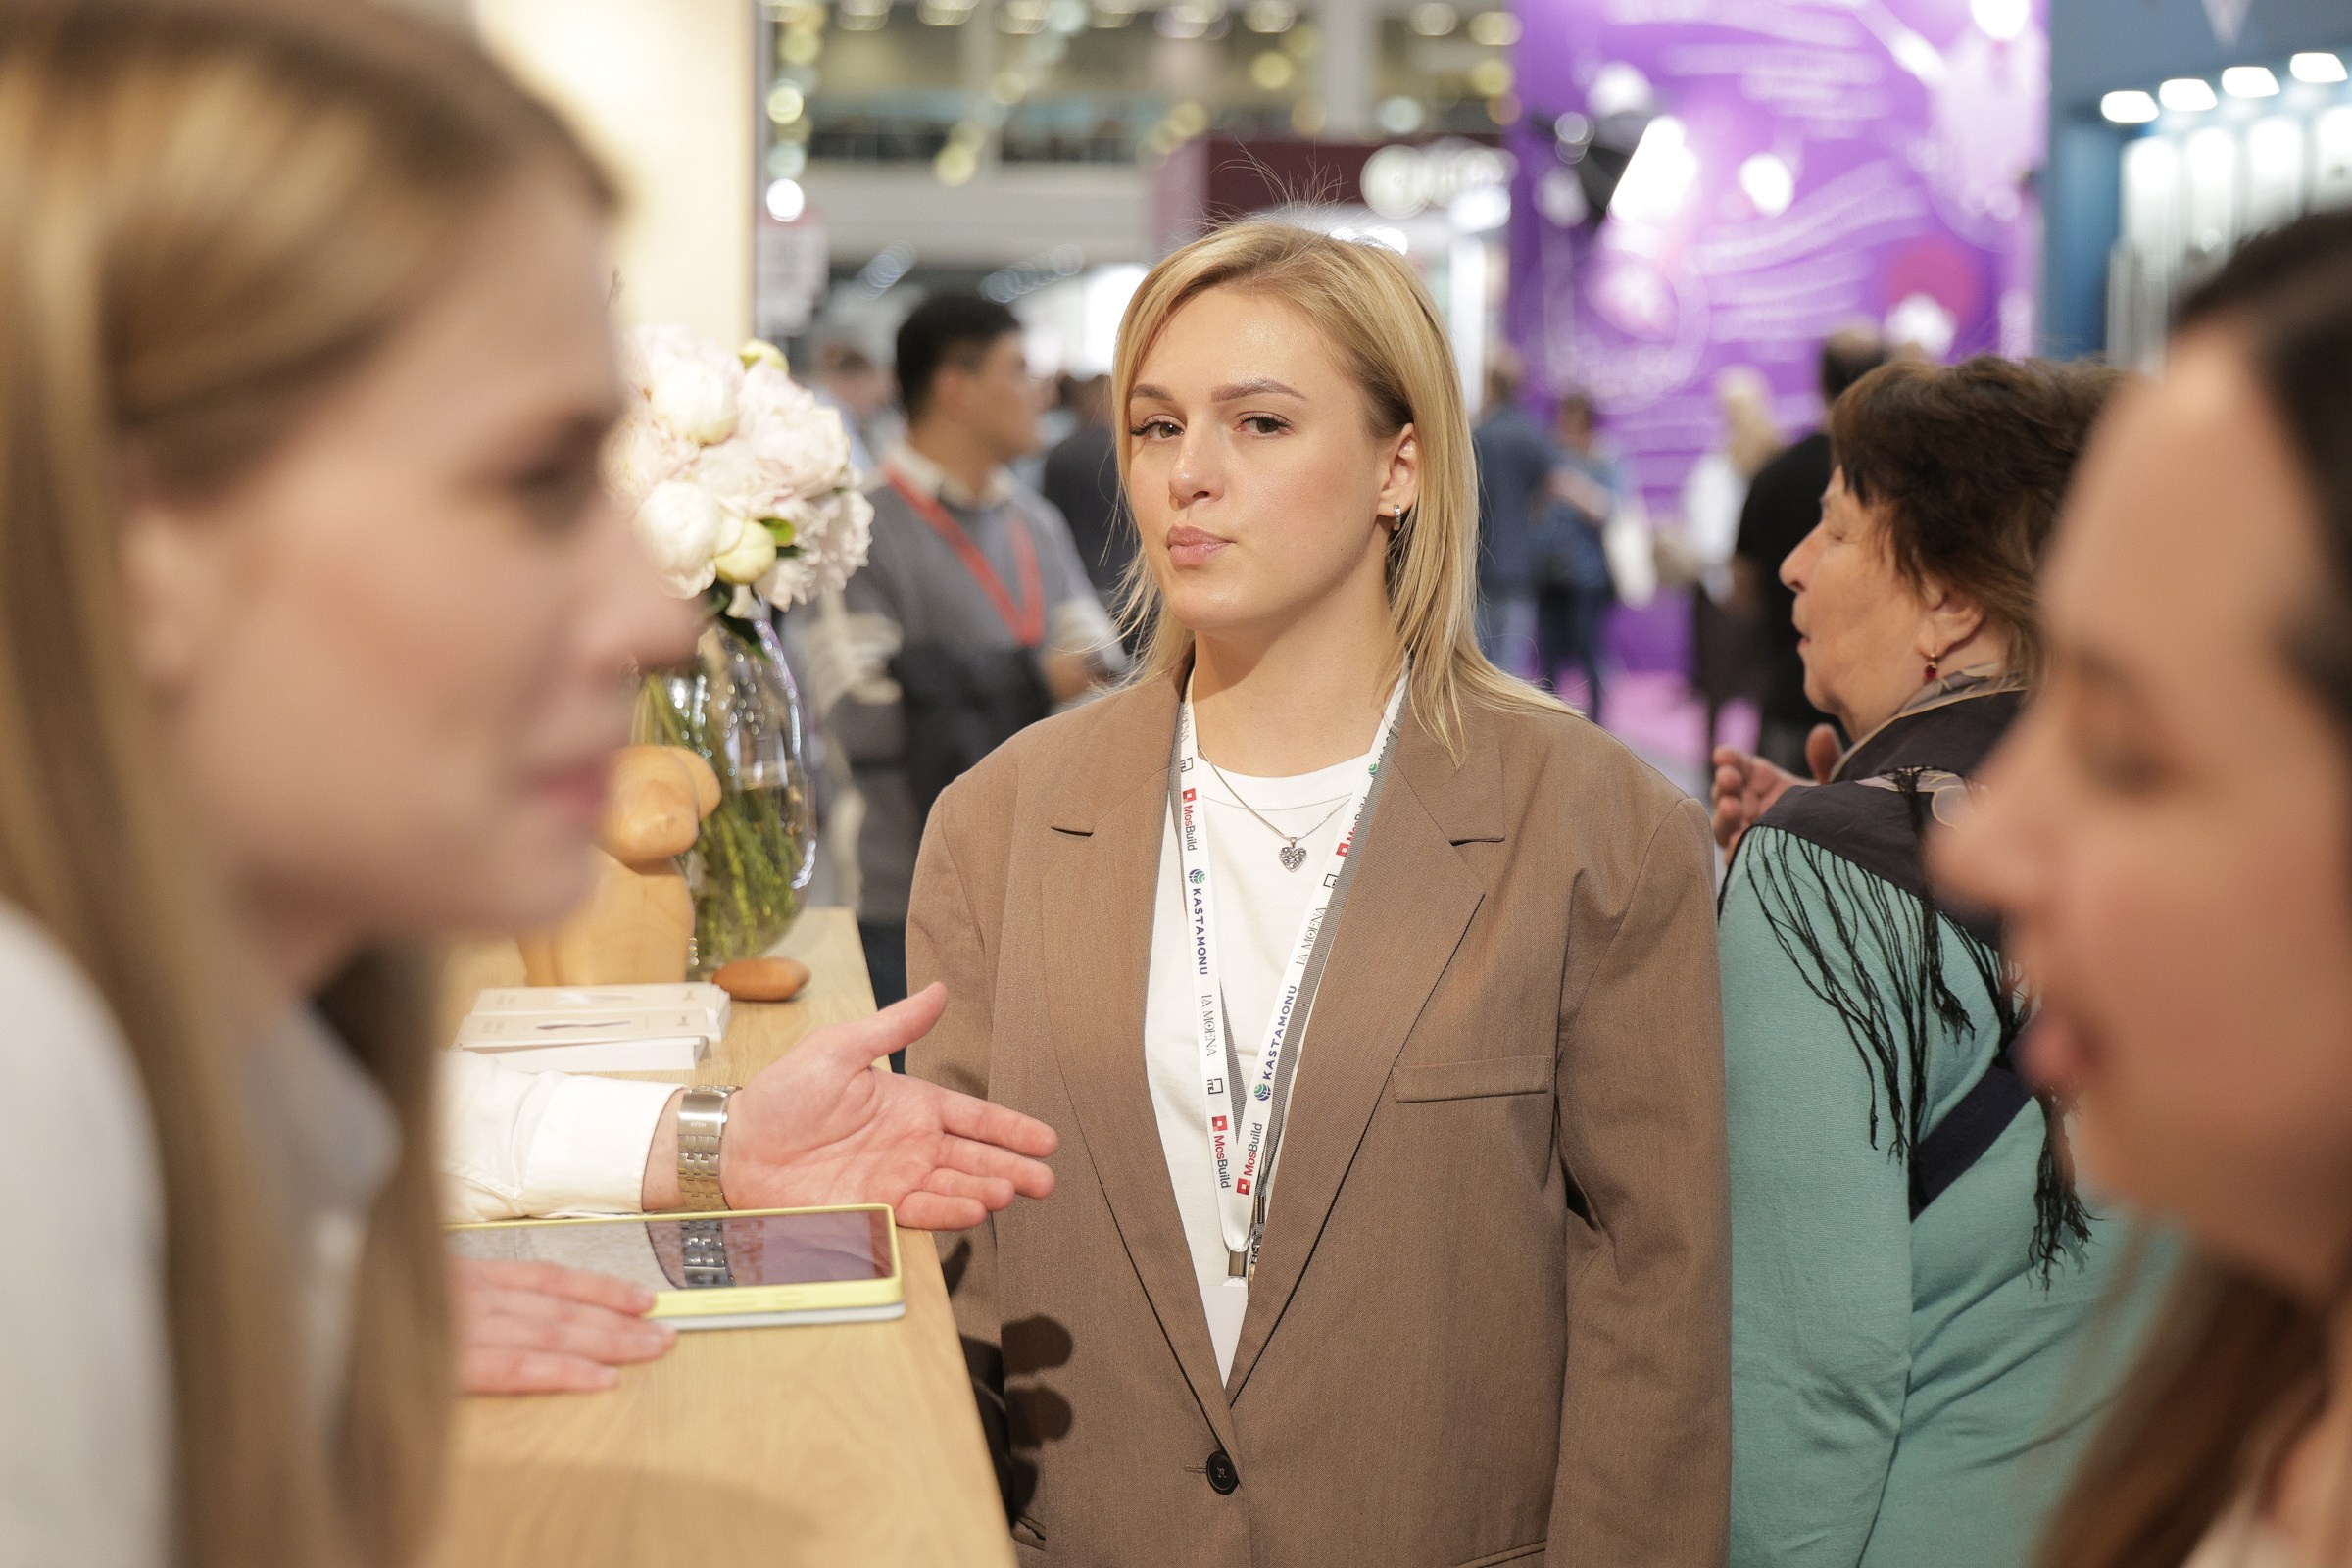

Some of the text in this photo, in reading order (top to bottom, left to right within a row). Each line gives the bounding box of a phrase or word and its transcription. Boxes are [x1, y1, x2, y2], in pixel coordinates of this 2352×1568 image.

[1184, 805, 1197, 851] MosBuild
[1193, 888, 1208, 975] KASTAMONU
[1301, 907, 1326, 950] MOENA
[1203, 1010, 1217, 1056] MOENA
[1262, 985, 1297, 1080] KASTAMONU
[1214, 1135, 1231, 1189] MosBuild
[1244, 1123, 1262, 1176] MosBuild
